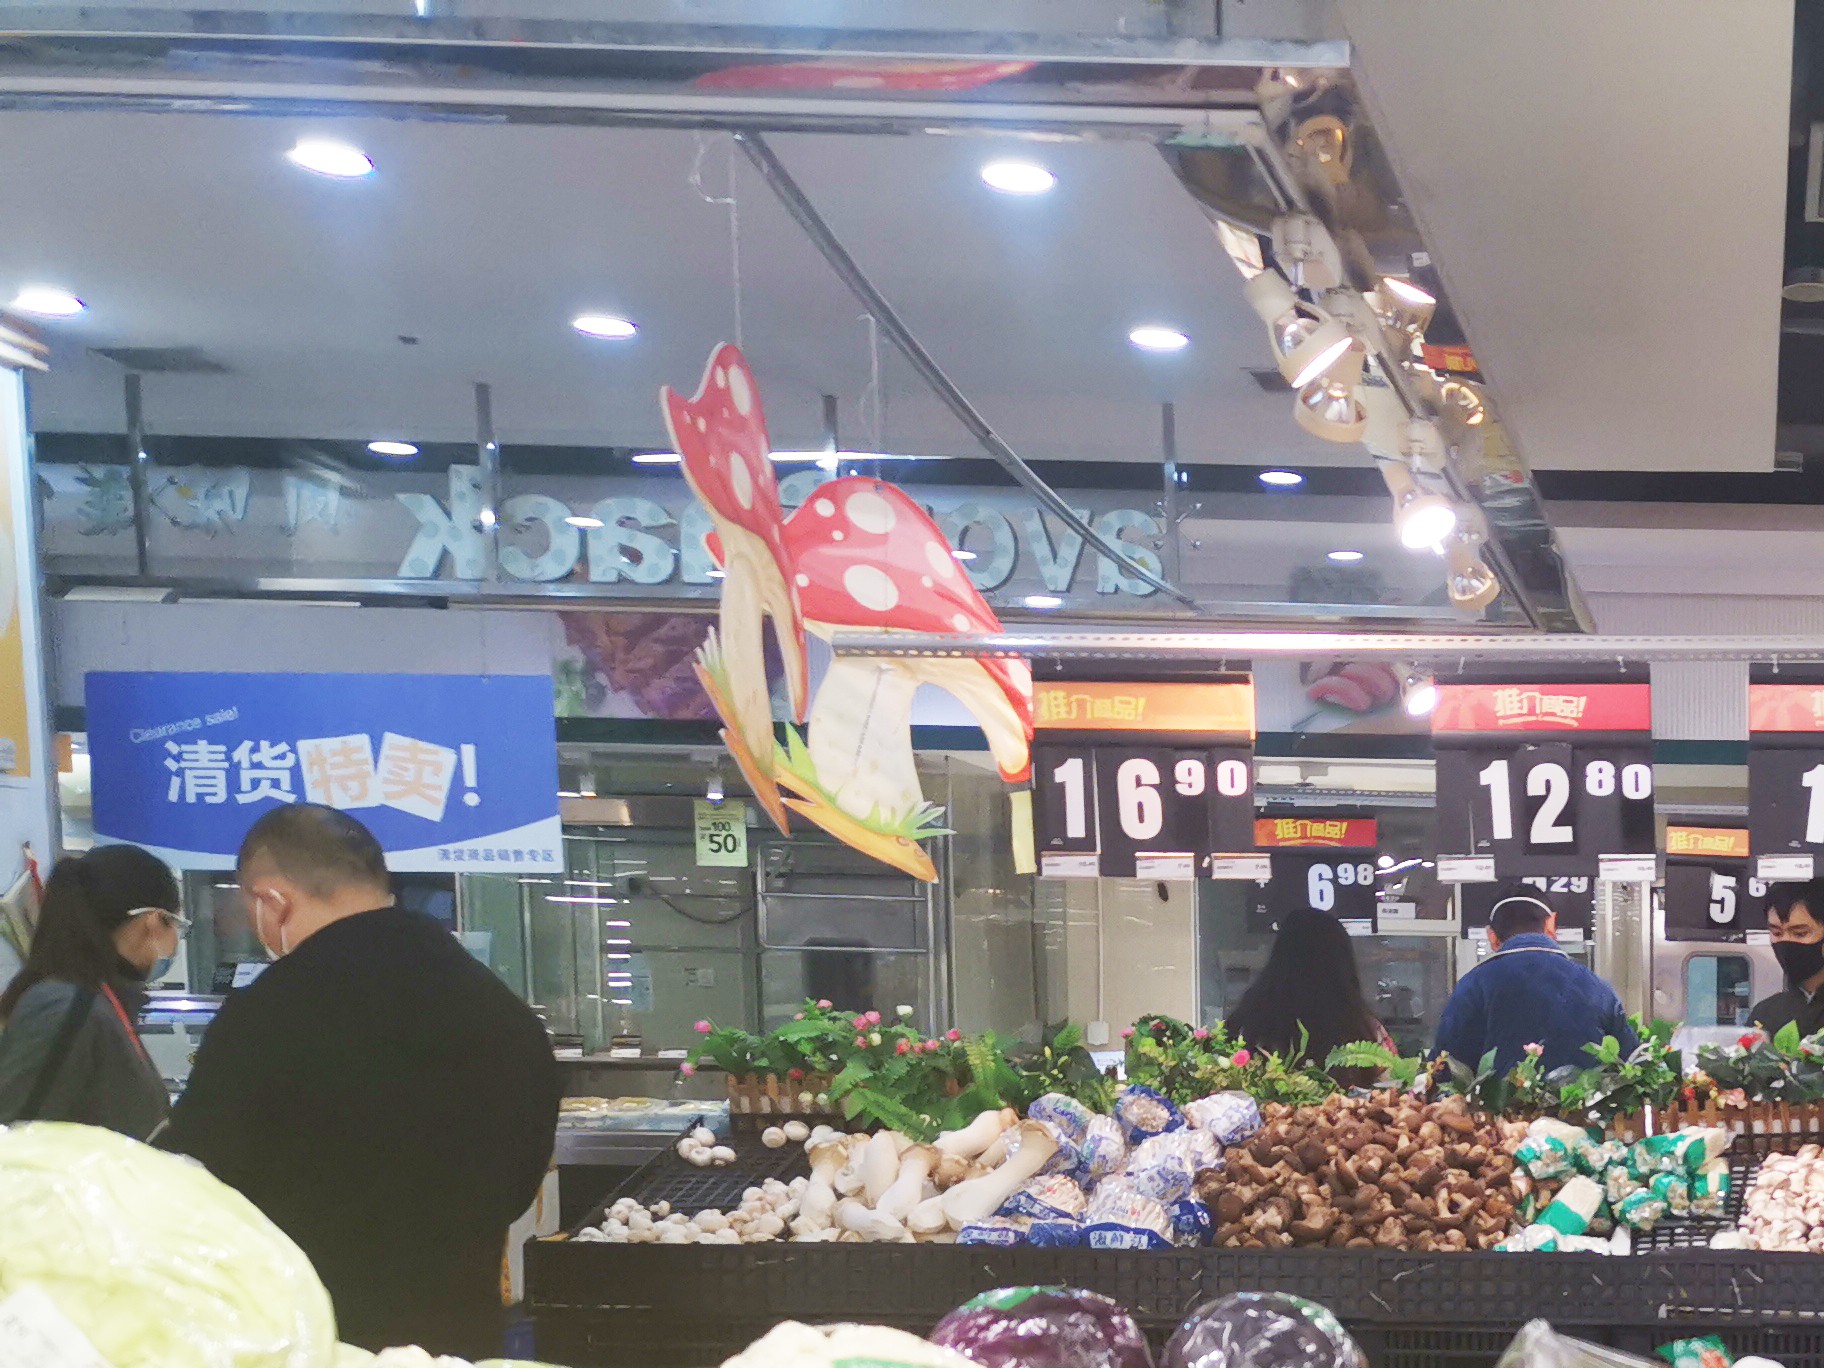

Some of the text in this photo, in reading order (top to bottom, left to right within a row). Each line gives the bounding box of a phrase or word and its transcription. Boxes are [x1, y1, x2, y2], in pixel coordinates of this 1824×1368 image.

[164, 738, 482, 808] 清货特卖!
[708, 833, 737, 853] 50
